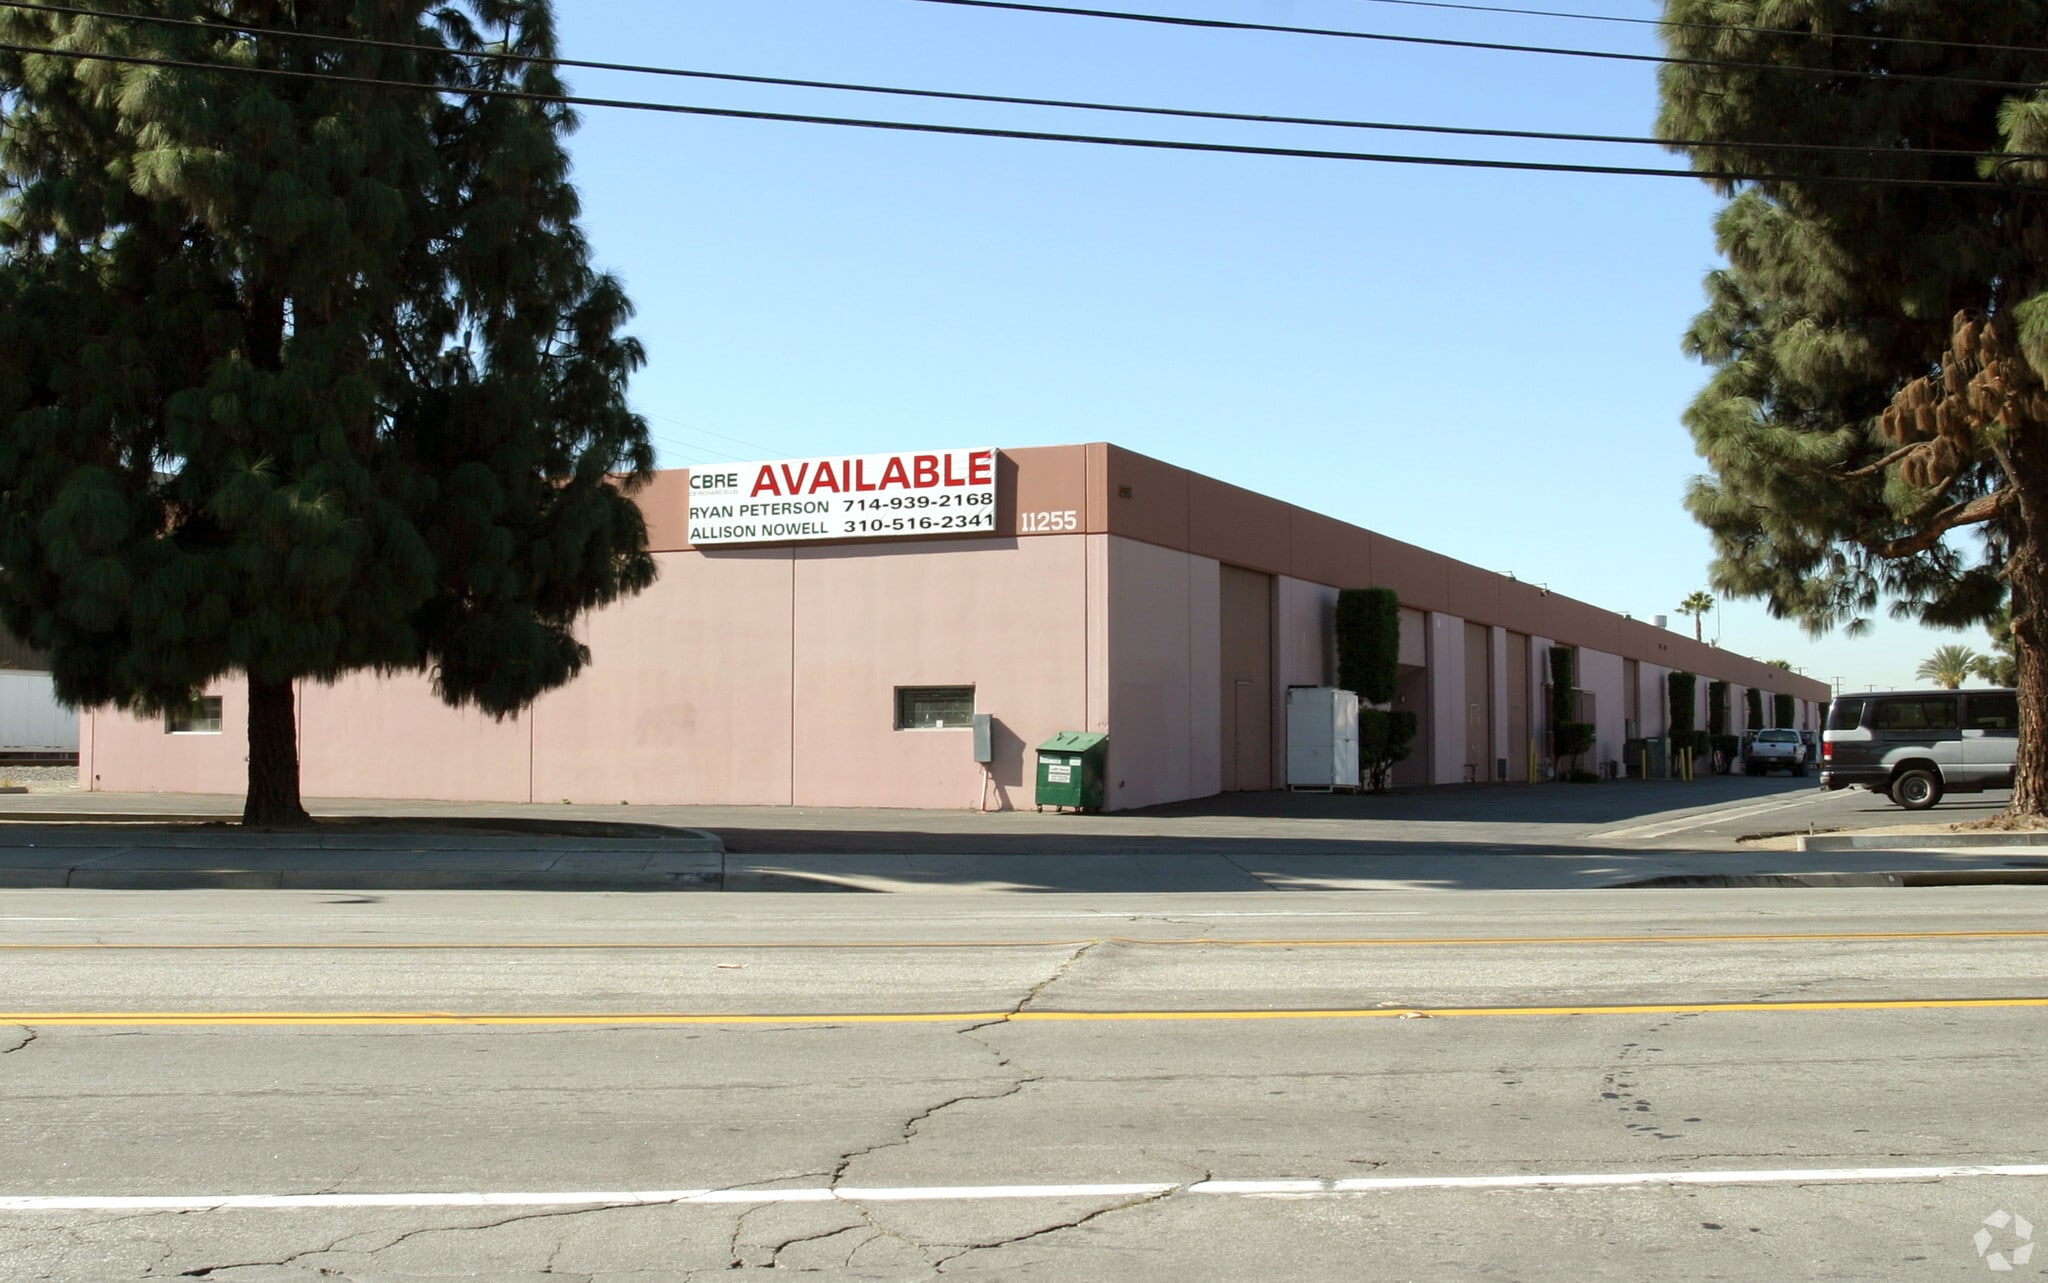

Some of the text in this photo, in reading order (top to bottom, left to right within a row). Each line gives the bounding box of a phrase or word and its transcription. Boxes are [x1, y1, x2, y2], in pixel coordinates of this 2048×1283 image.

[689, 473, 738, 489] CBRE
[750, 451, 992, 497] AVAILABLE
[690, 492, 993, 519] RYAN PETERSON 714-939-2168
[690, 513, 993, 540] ALLISON NOWELL 310-516-2341
[1021, 510, 1077, 532] 11255
